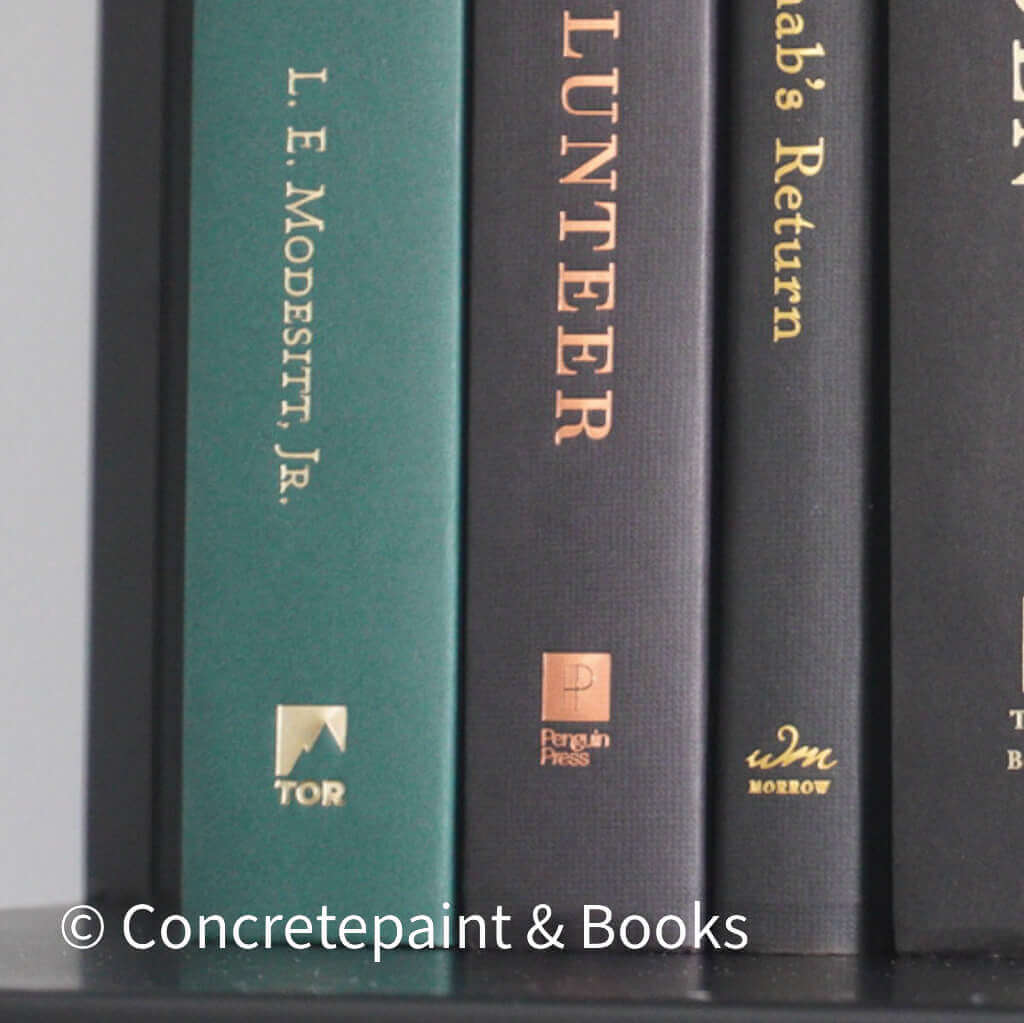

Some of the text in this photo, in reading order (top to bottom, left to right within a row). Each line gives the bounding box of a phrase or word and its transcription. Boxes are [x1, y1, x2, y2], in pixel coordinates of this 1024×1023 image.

[287, 67, 328, 107] L.
[286, 126, 327, 166] E.
[773, 136, 825, 343] Return
[541, 728, 611, 749] Penguin
[540, 748, 591, 767] Press
[274, 779, 345, 807] TOR
[749, 779, 831, 795] MORROW
